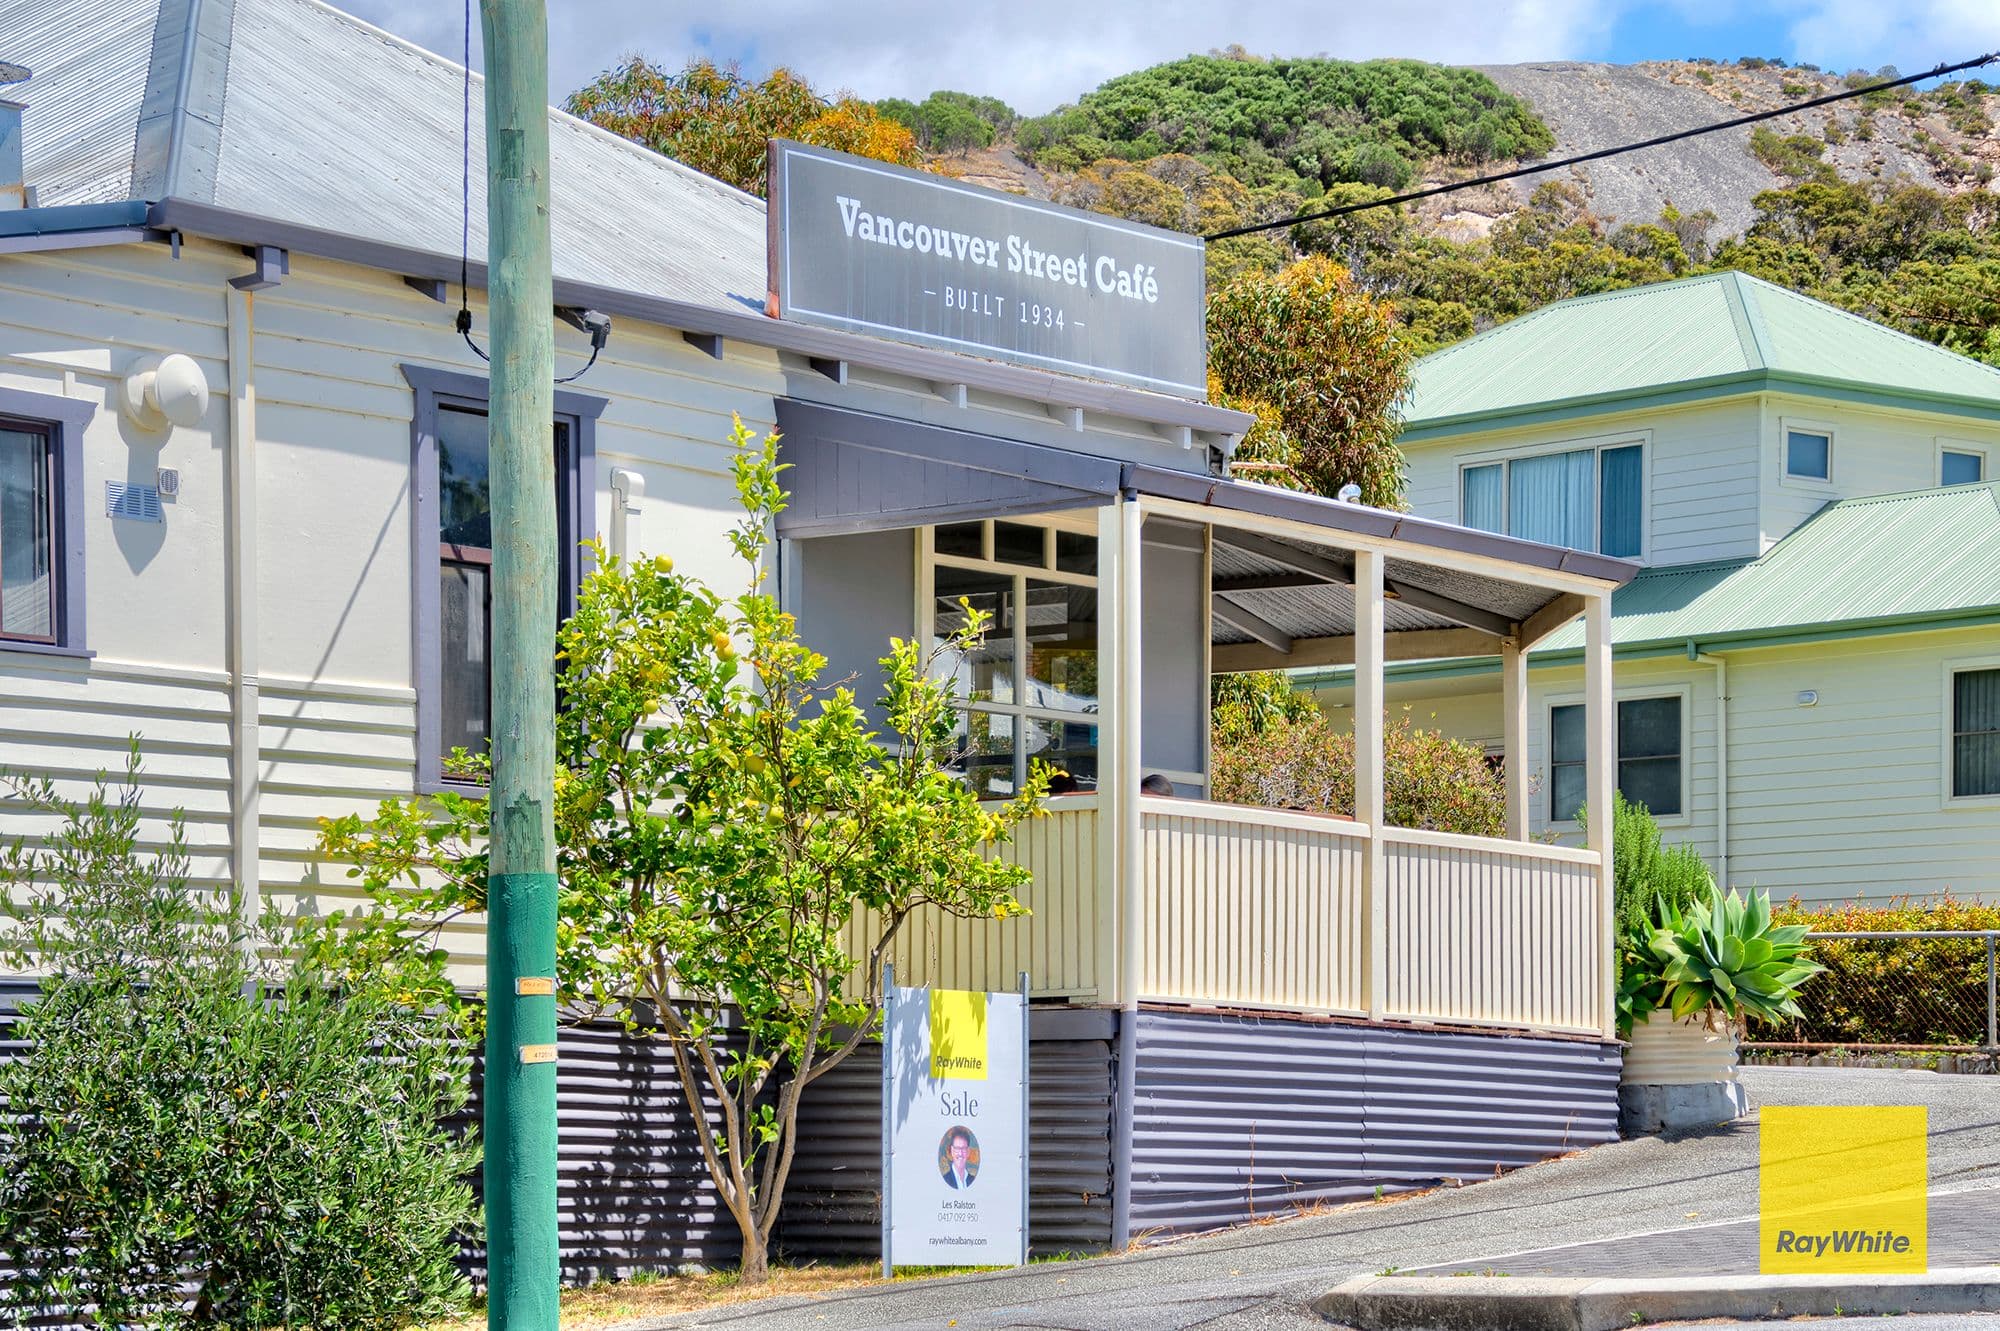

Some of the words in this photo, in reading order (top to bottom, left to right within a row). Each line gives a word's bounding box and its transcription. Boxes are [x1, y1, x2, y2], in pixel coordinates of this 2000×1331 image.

[836, 195, 1000, 268] Vancouver
[1007, 234, 1088, 288] Street
[1095, 255, 1159, 304] Café
[945, 286, 1005, 318] BUILT
[1020, 301, 1065, 331] 1934
[936, 1055, 982, 1070] RayWhite
[940, 1091, 978, 1117] Sale
[942, 1200, 953, 1209] Les
[953, 1200, 976, 1209] Ralston
[937, 1212, 953, 1222] 0417
[954, 1212, 966, 1222] 092
[928, 1236, 988, 1246] raywhitealbany.com
